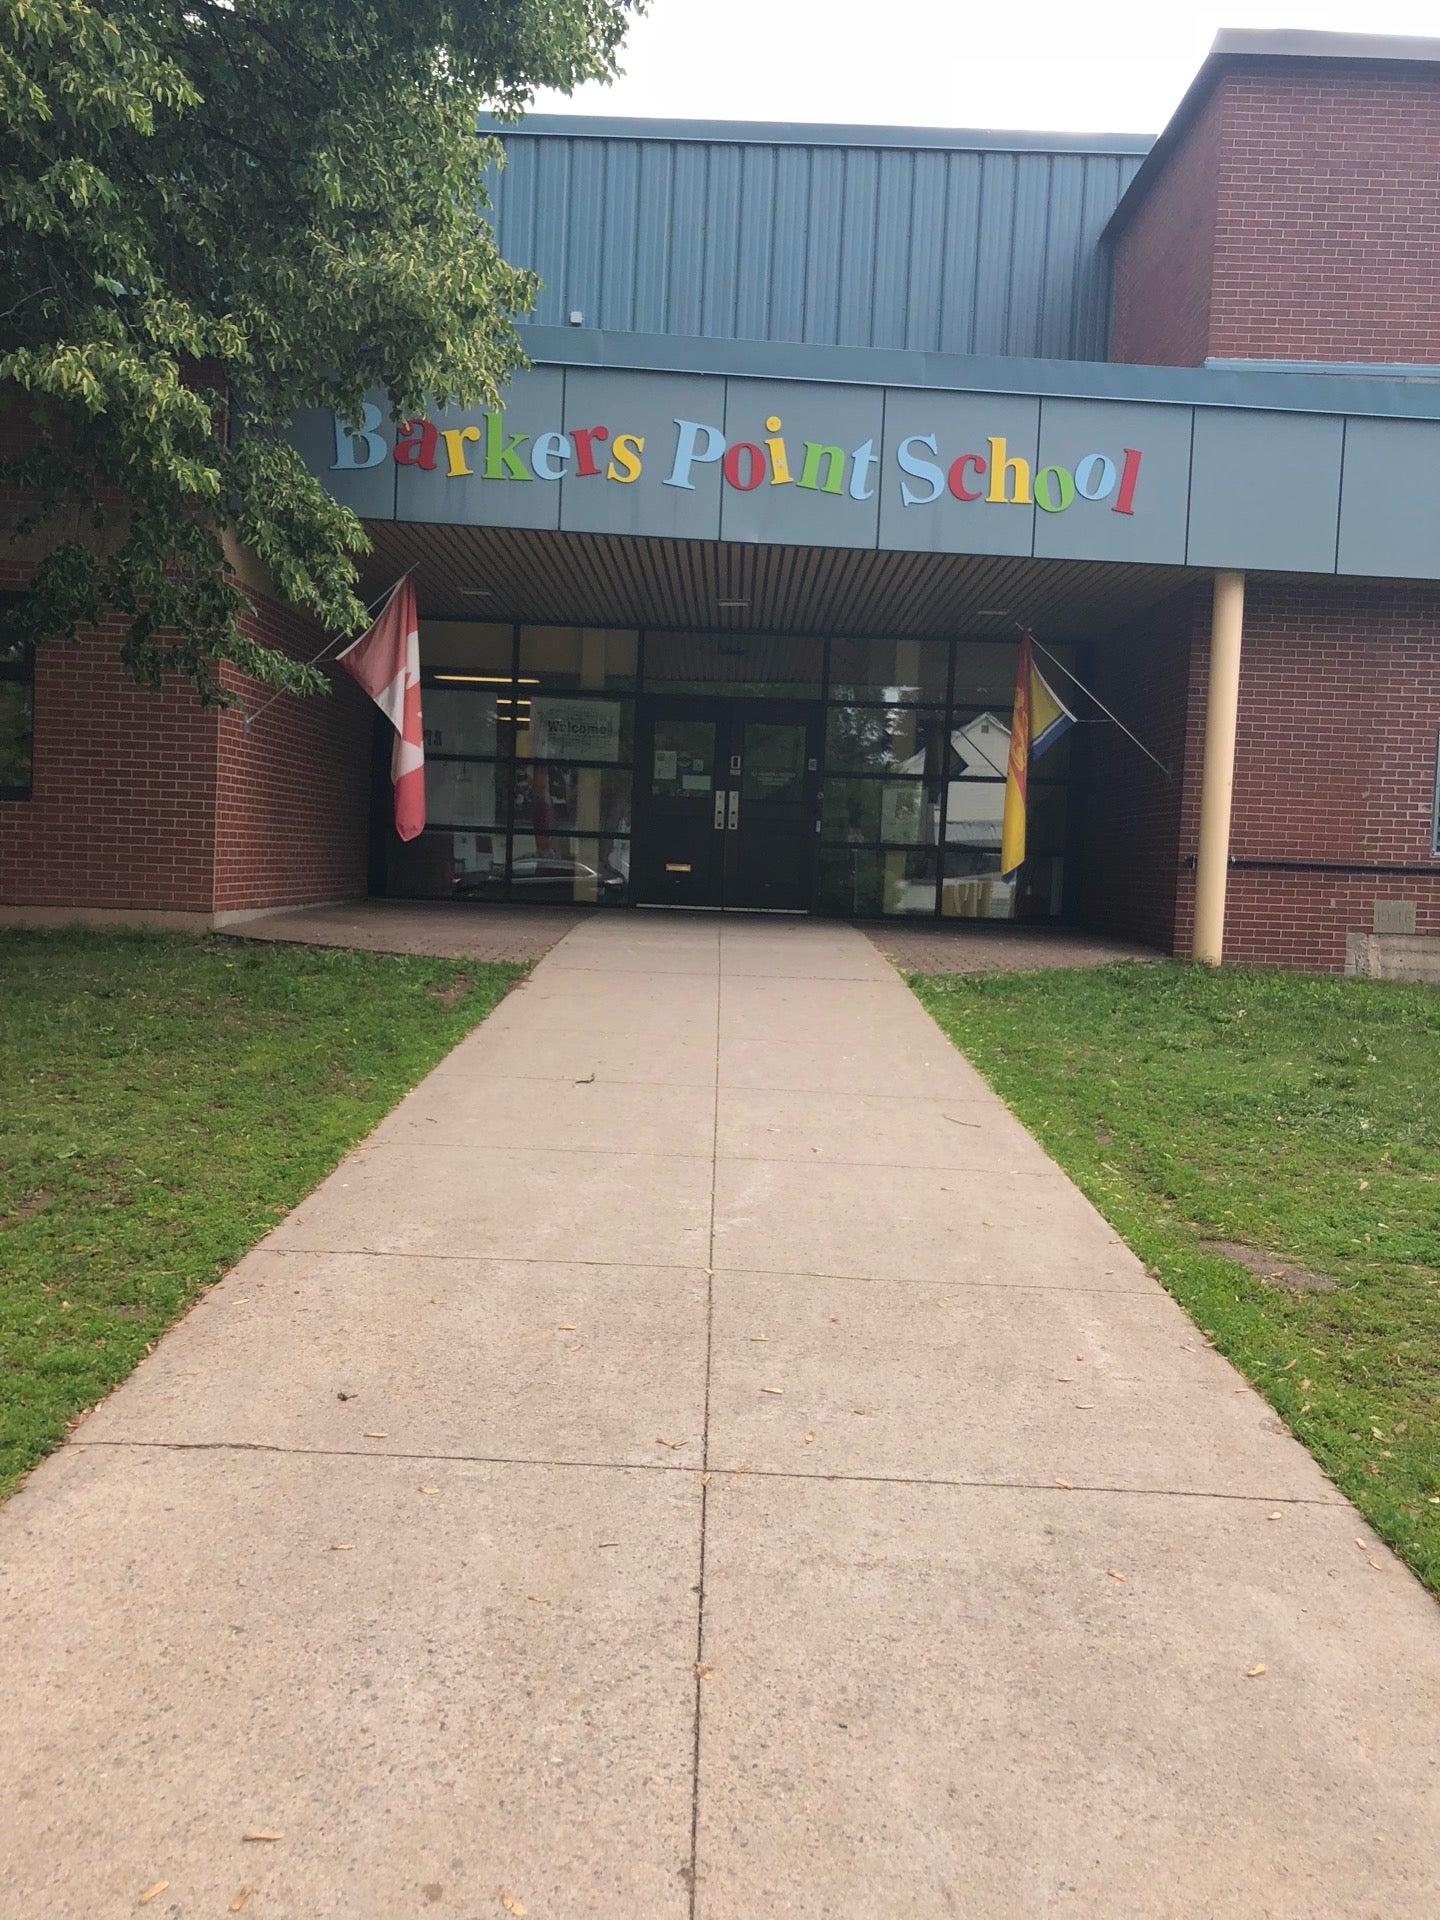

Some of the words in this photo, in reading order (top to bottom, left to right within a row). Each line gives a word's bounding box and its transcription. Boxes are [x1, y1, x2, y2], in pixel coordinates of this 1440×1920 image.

[329, 400, 645, 484] Barkers
[662, 416, 879, 501] Point
[897, 433, 1143, 516] School
